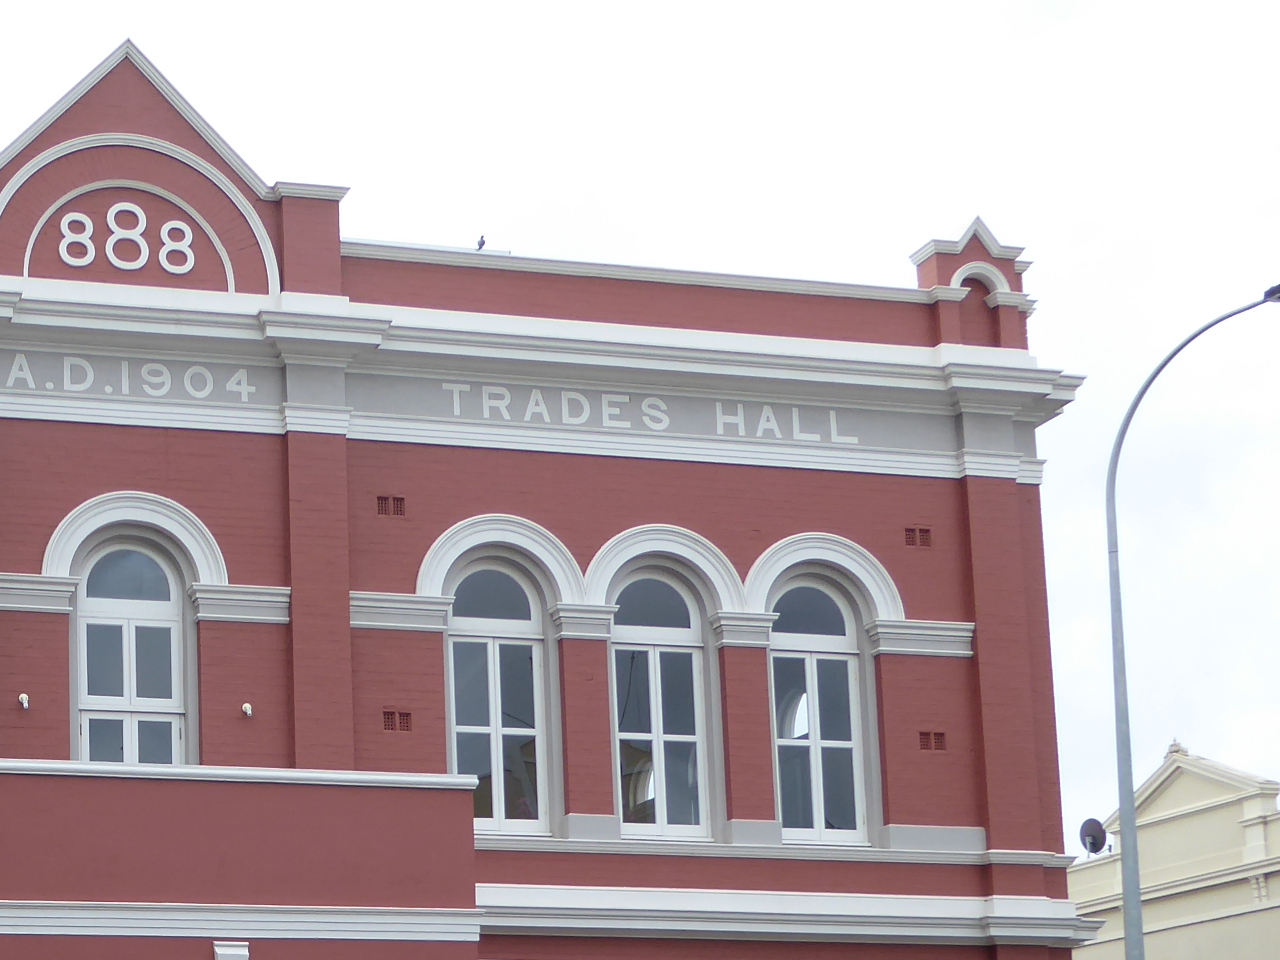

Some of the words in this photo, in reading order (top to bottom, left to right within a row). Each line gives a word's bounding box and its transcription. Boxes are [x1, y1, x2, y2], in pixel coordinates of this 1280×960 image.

[58, 202, 195, 275] 888
[441, 382, 670, 431] TRADES
[716, 401, 859, 444] HALL
